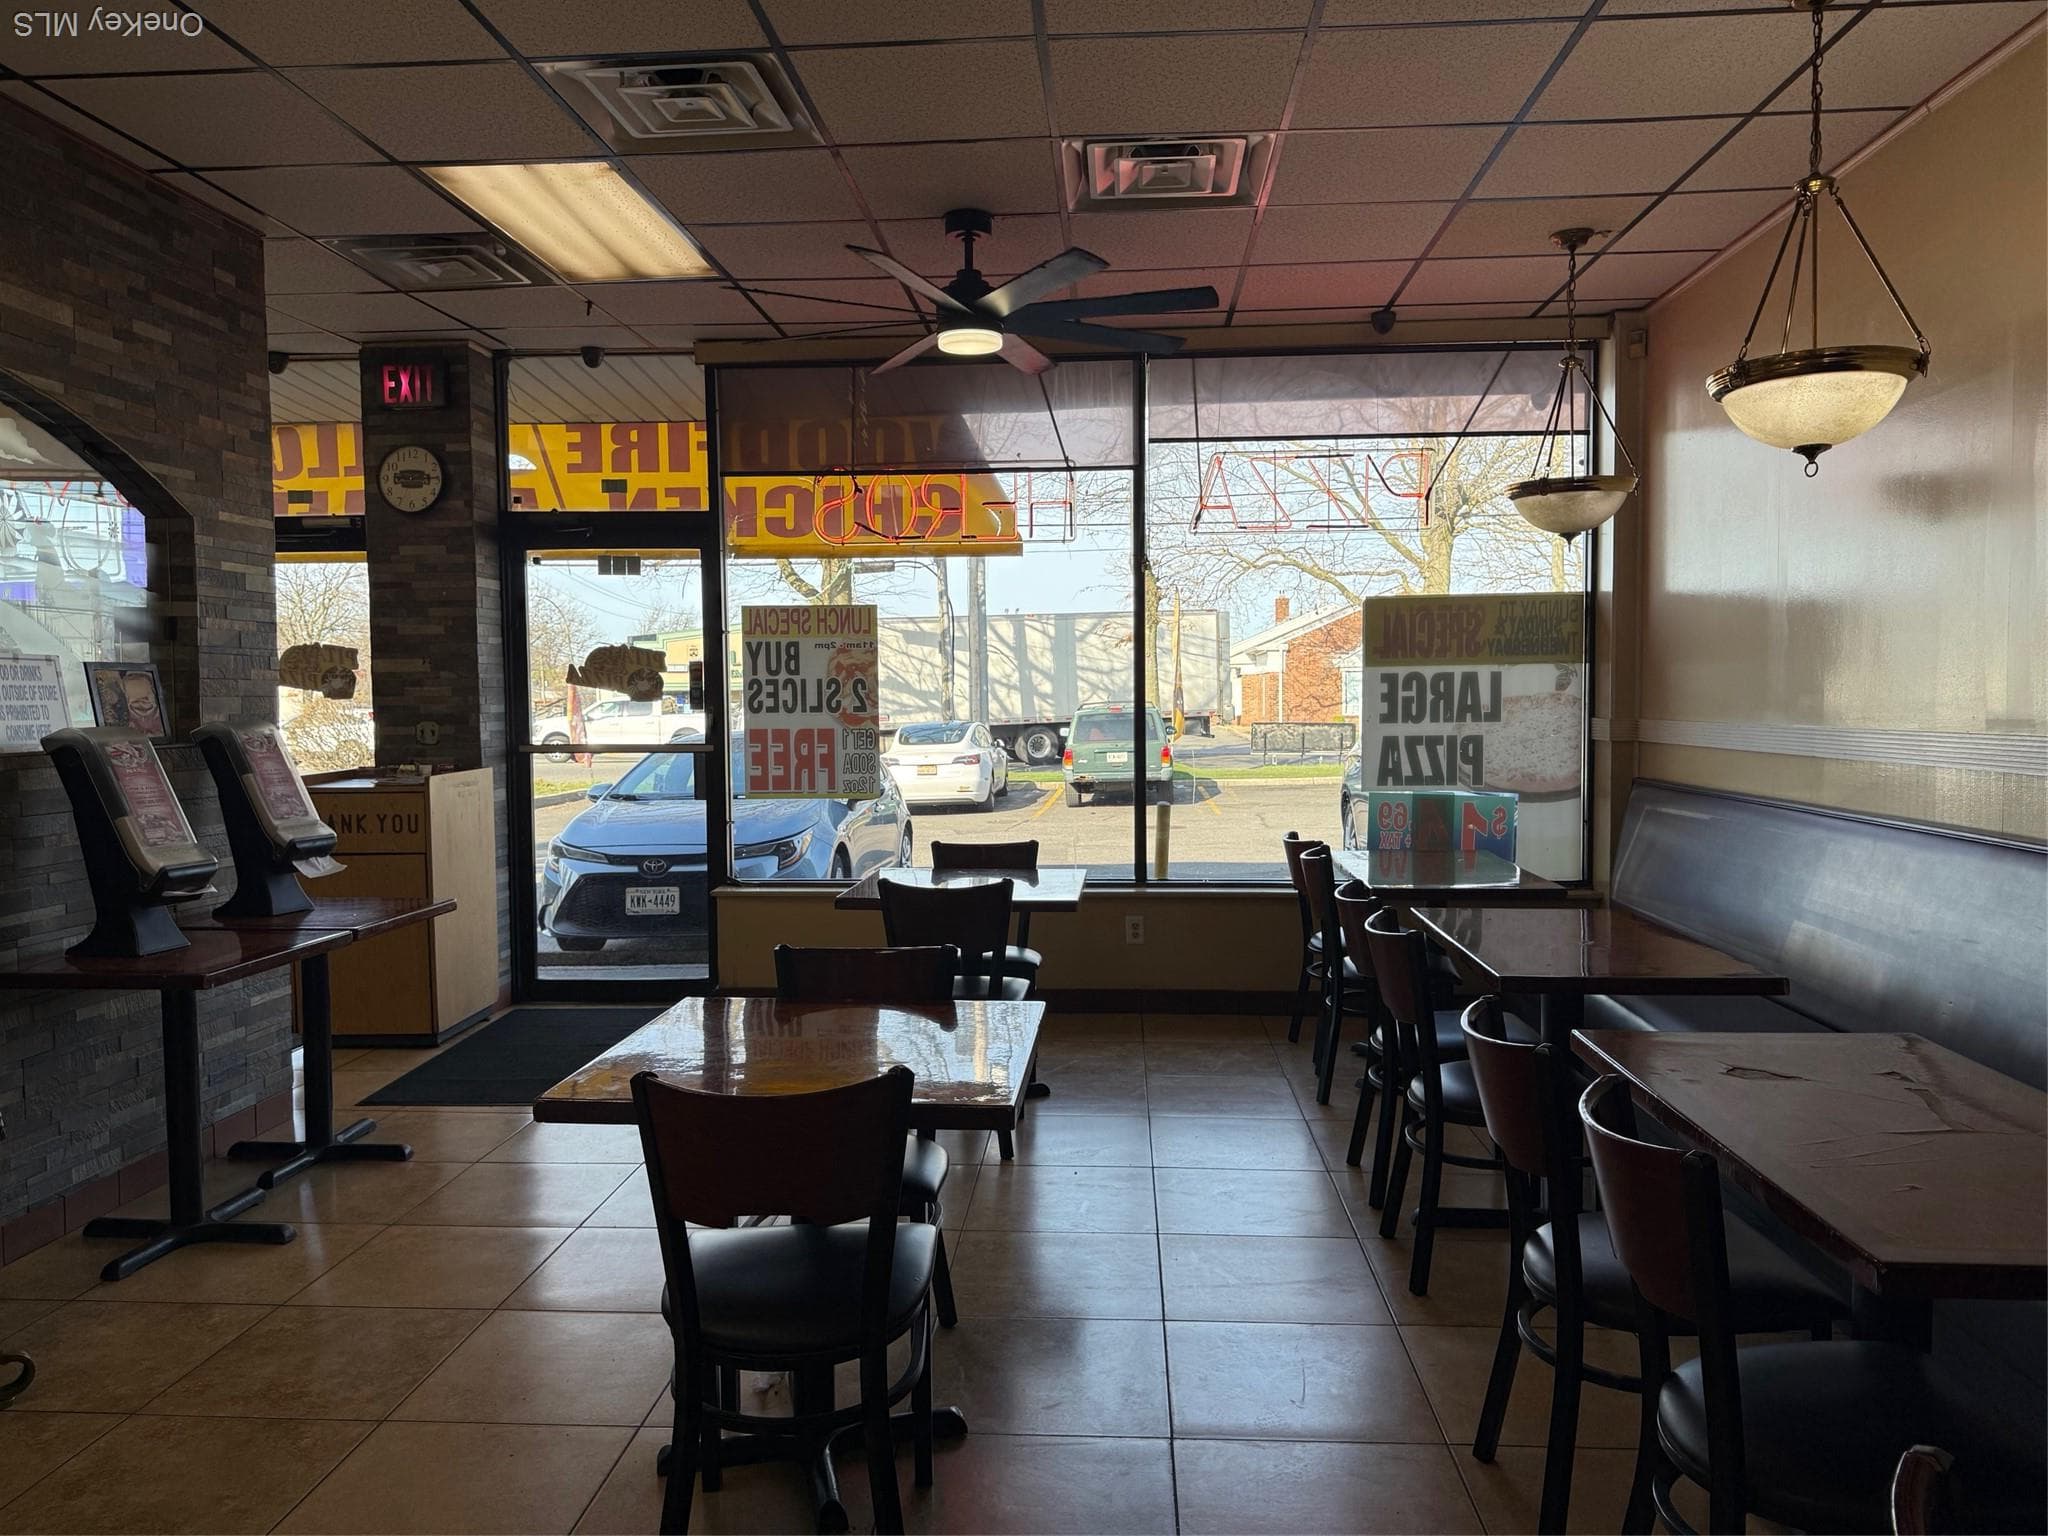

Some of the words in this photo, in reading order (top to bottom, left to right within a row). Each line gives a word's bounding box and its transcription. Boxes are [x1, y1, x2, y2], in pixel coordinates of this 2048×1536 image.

[383, 365, 432, 404] EXIT
[2, 684, 28, 702] OUTSIDE
[41, 704, 50, 721] TO
[326, 813, 367, 833] ANK
[377, 813, 418, 833] YOU
